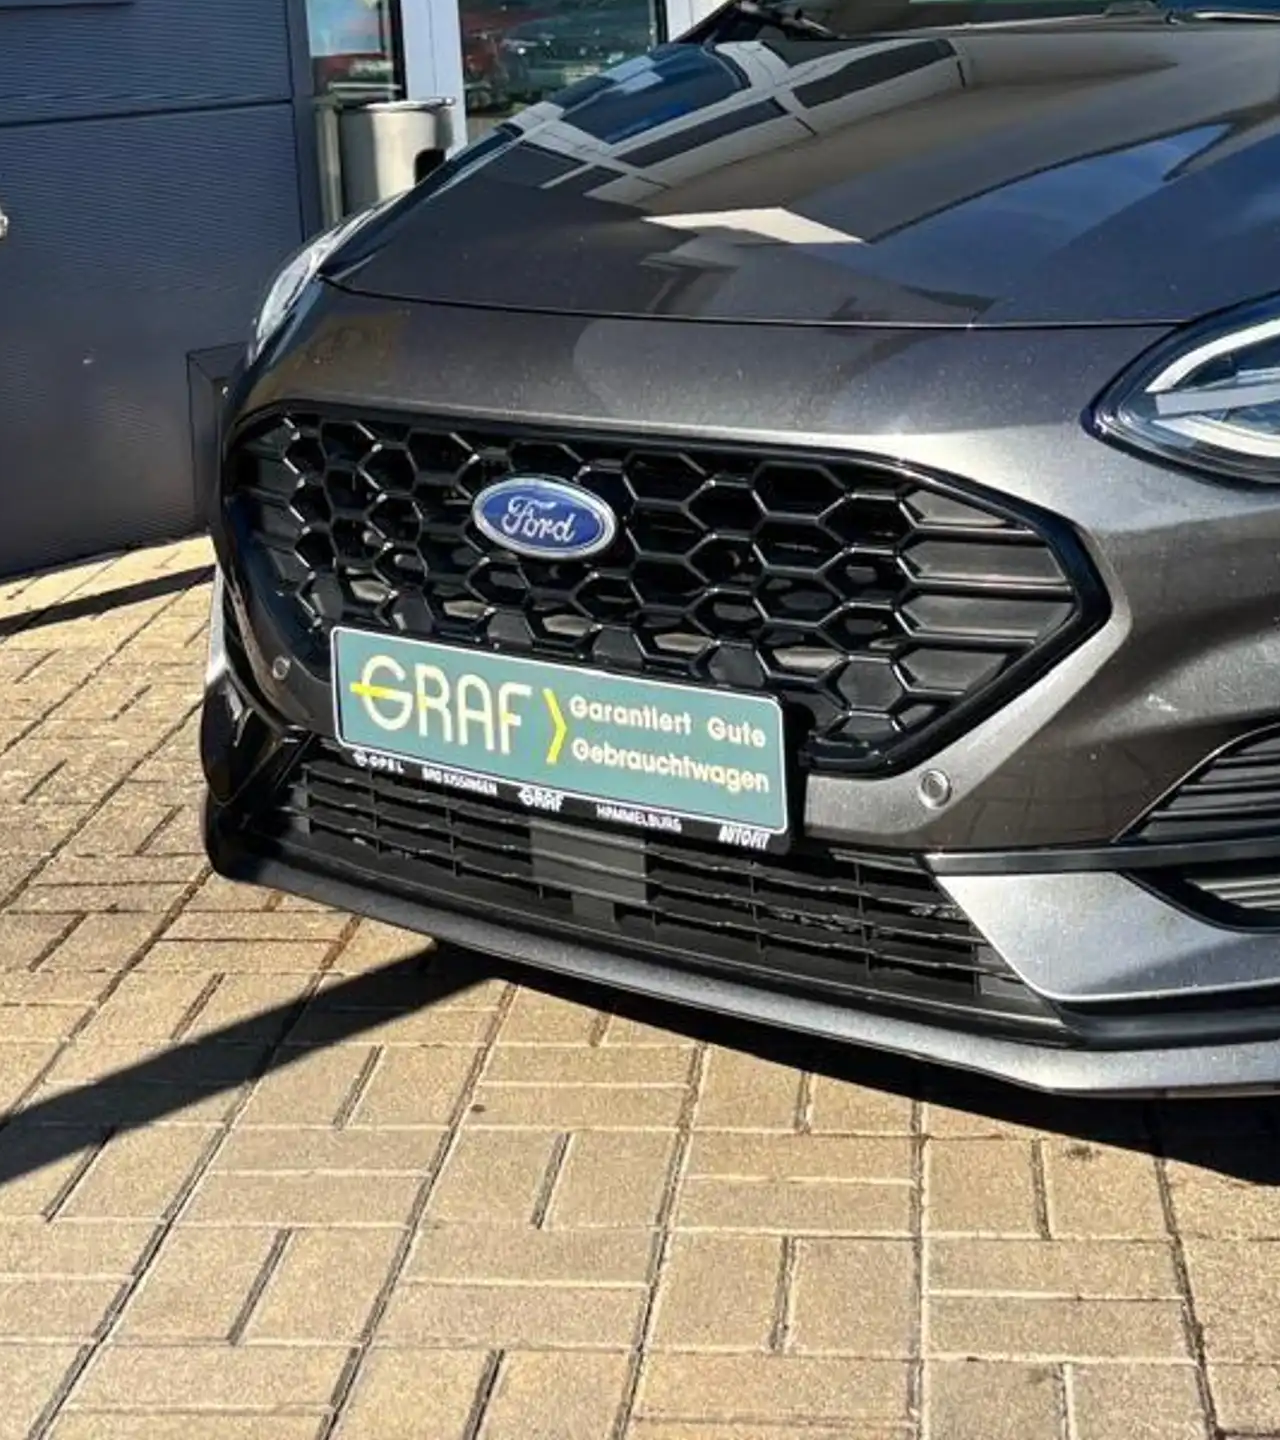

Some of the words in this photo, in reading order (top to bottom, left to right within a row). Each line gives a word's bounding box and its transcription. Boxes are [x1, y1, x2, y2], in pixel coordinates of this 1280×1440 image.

[501, 496, 577, 542] Ford
[350, 655, 533, 755] GRAF
[569, 694, 692, 736] Garantiert
[707, 716, 767, 748] Gute
[571, 737, 770, 794] Gebrauchtwagen
